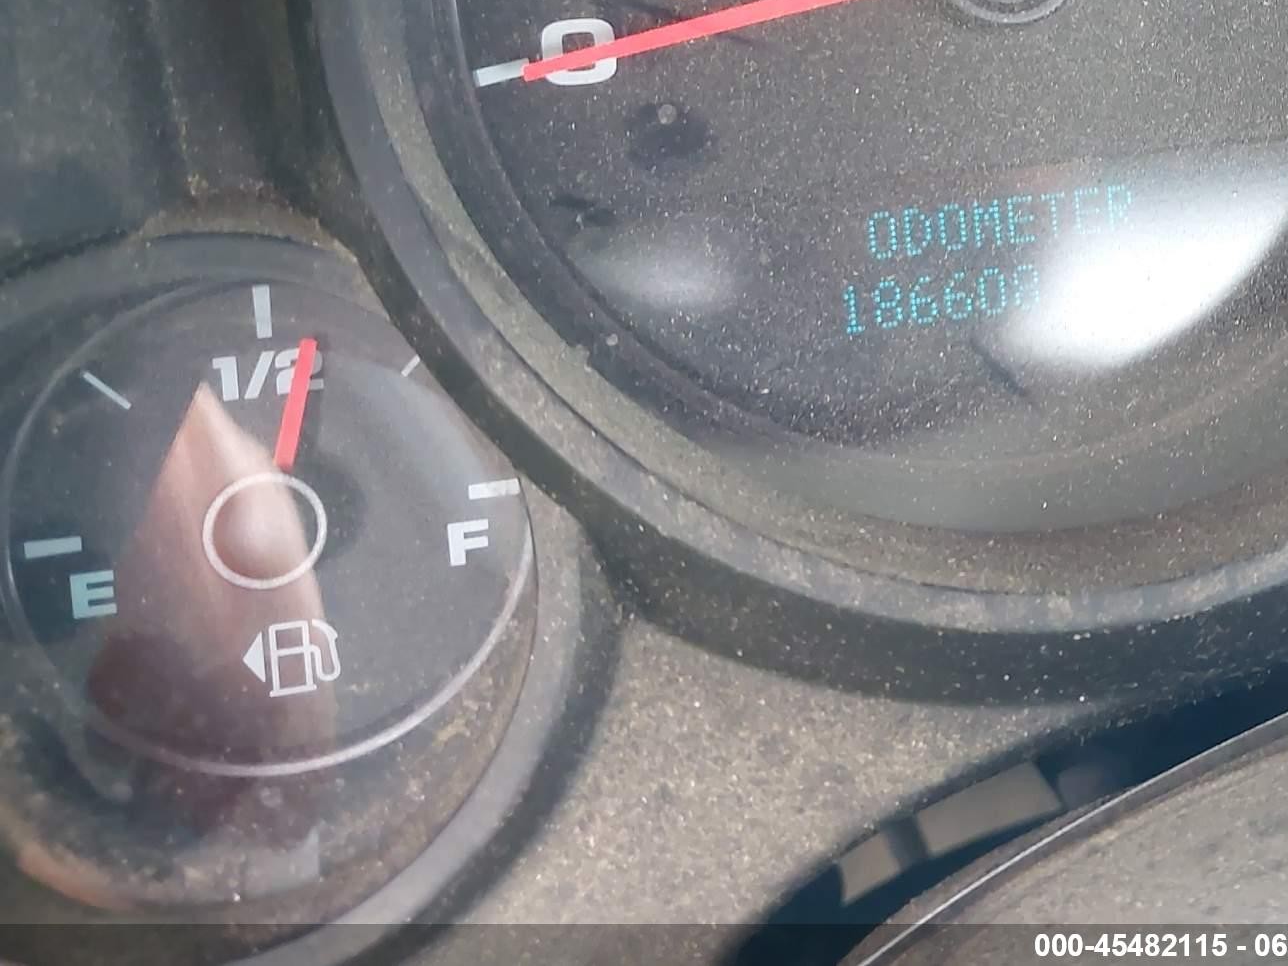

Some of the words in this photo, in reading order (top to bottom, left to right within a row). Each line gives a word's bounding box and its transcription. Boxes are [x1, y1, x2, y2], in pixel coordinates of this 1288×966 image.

[541, 18, 618, 86] 0
[867, 184, 1136, 260] ODOMETER
[212, 348, 325, 402] 1/2
[446, 519, 489, 566] F
[69, 570, 117, 619] E
